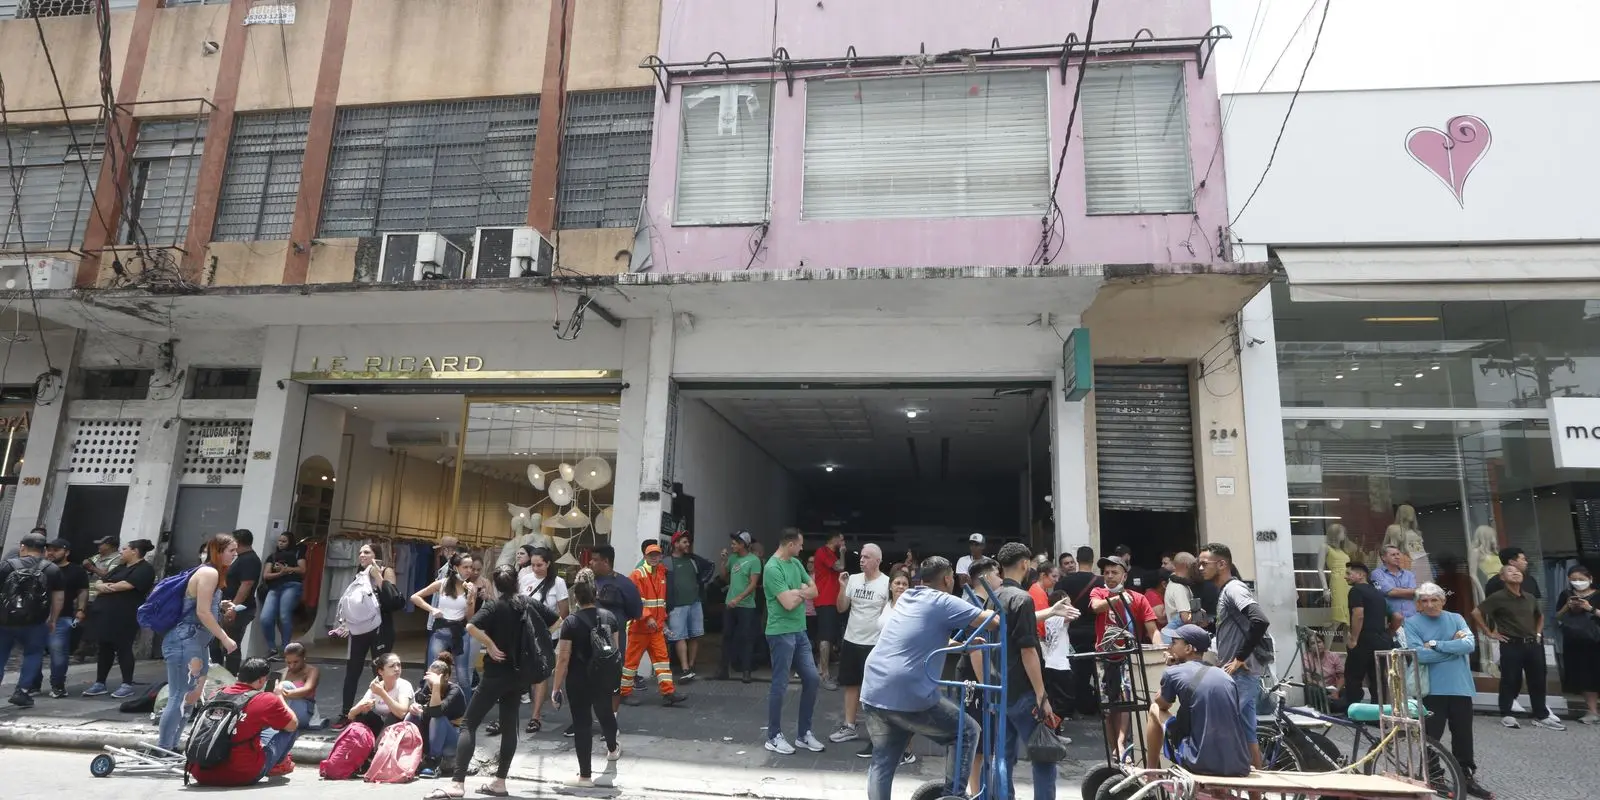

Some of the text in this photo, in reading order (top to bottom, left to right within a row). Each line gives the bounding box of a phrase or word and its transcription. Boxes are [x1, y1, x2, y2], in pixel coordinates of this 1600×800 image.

[312, 356, 484, 372] LE RICARD
[1209, 429, 1238, 440] 284
[853, 588, 875, 600] MIAMI
